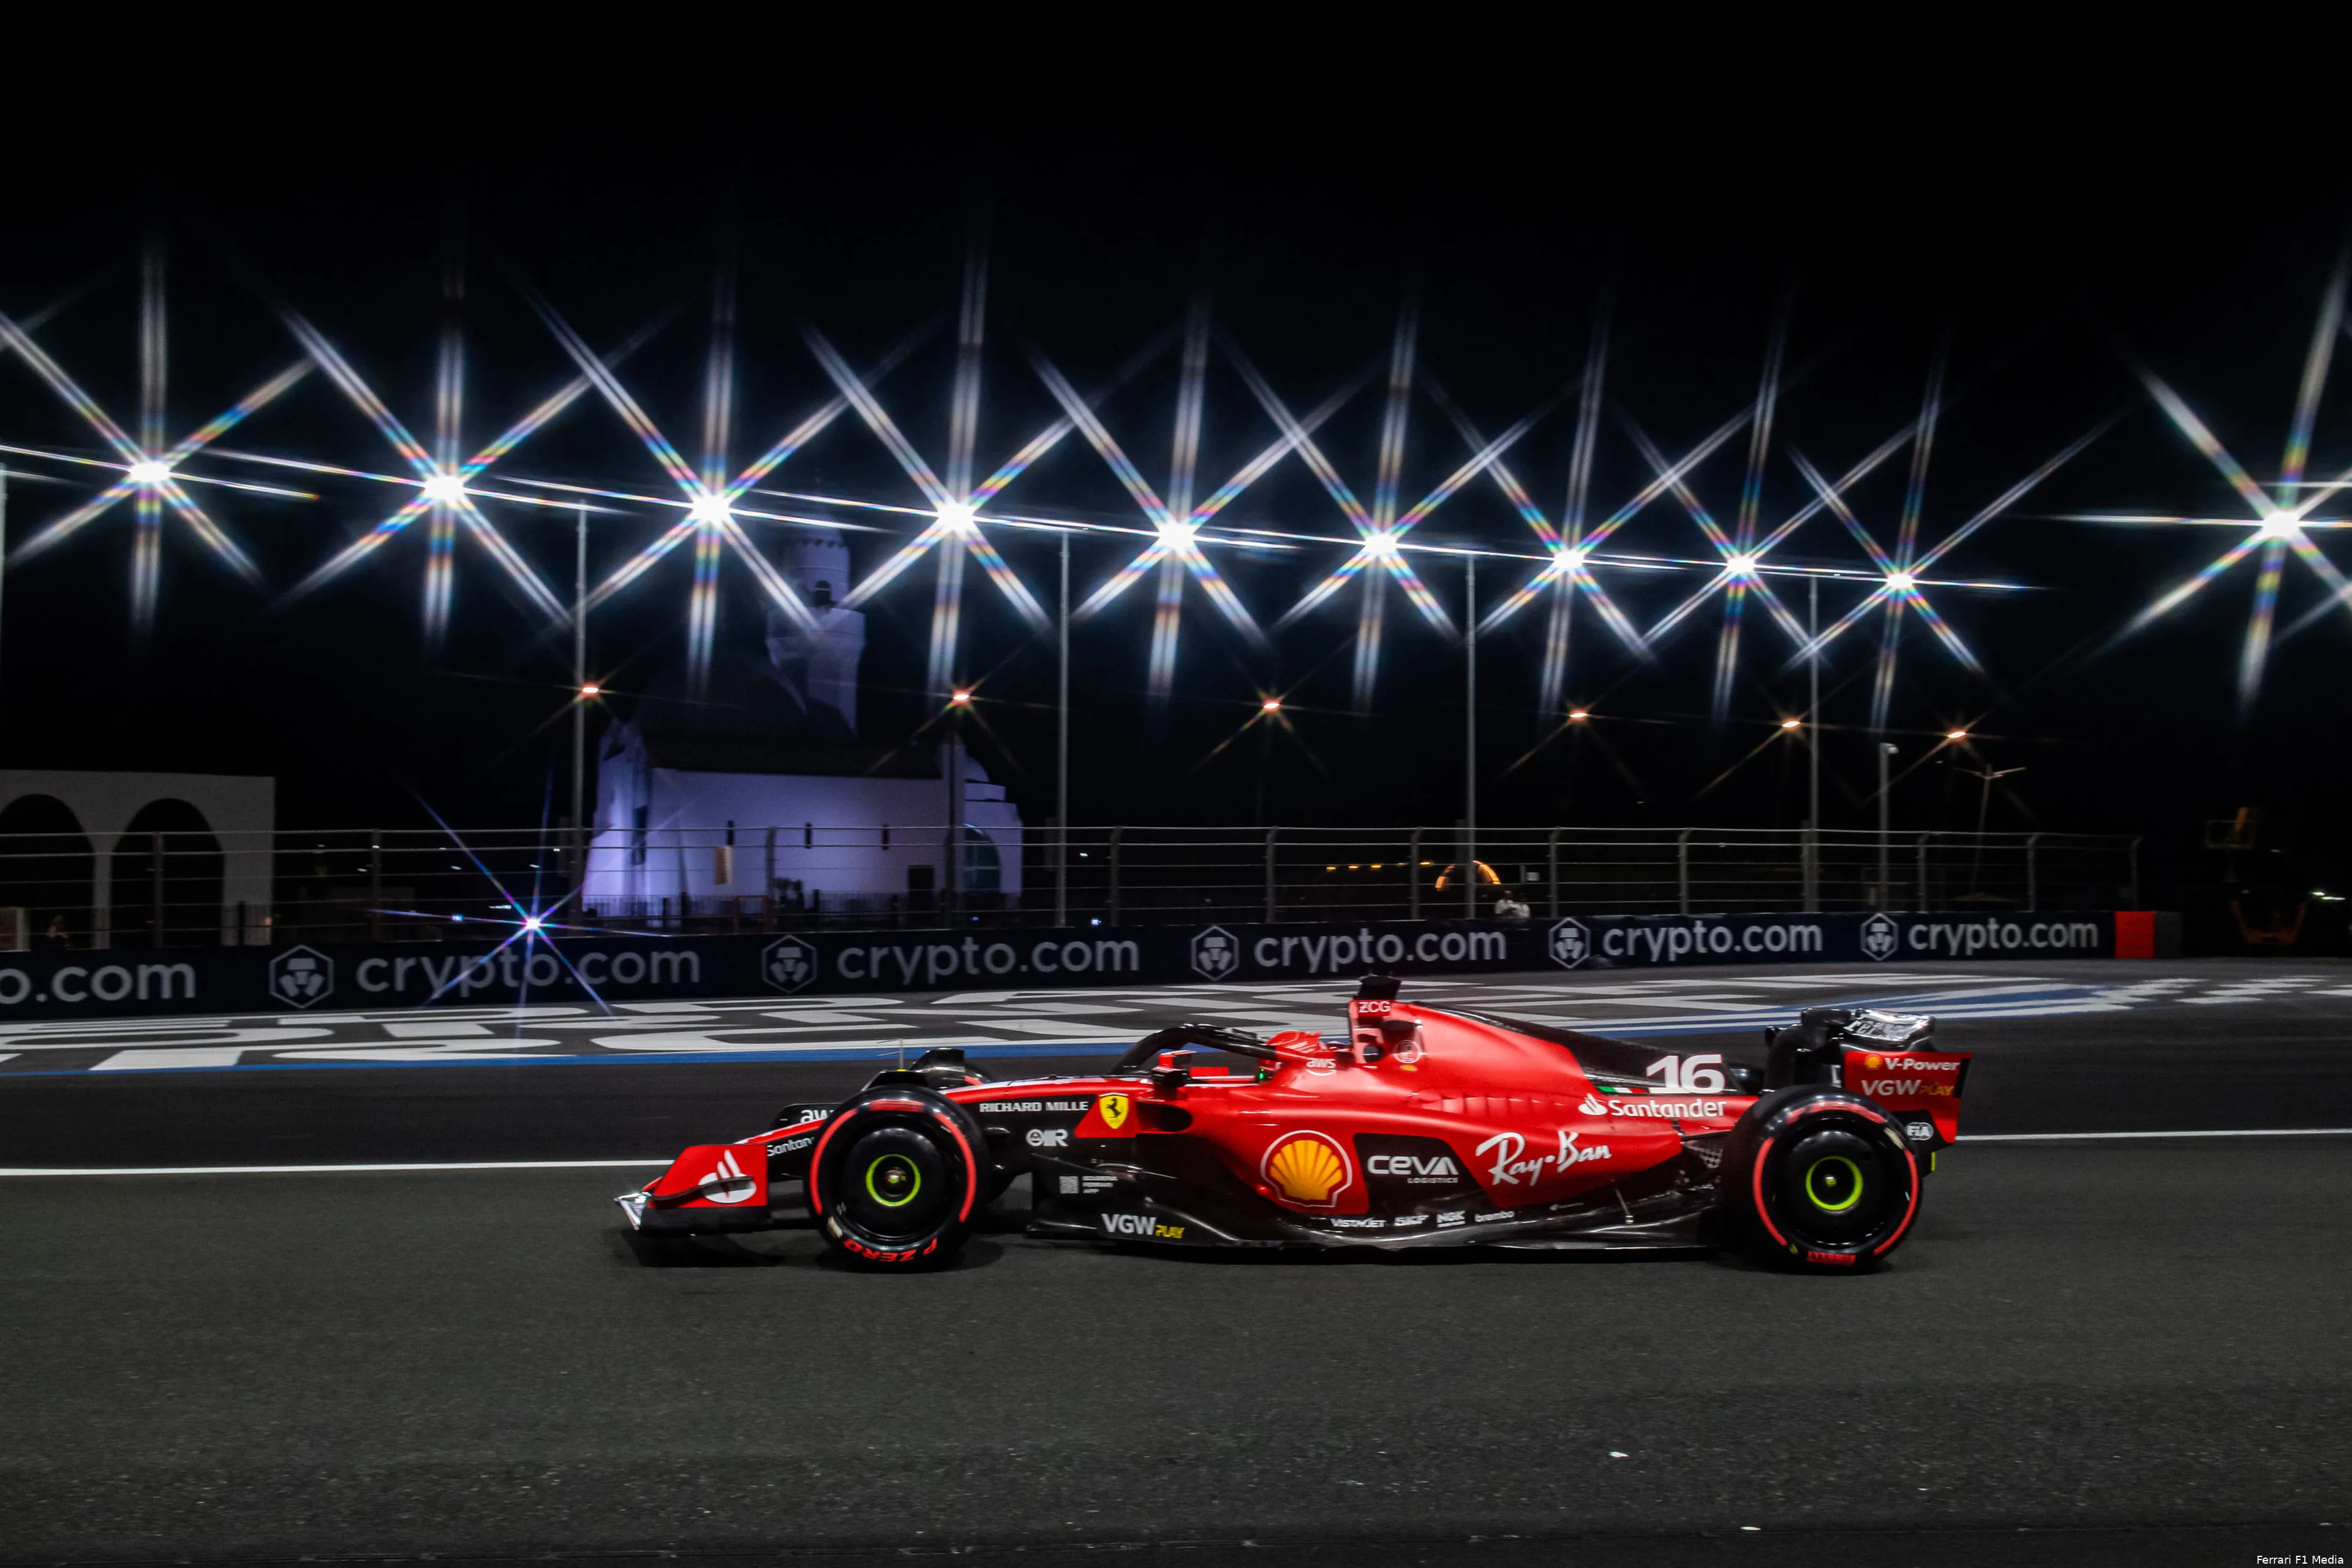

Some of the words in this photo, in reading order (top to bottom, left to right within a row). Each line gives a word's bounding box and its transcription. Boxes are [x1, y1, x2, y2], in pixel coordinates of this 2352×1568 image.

[1602, 920, 1823, 962] crypto.com
[1908, 918, 2098, 956] crypto.com
[837, 937, 1139, 984] crypto.com
[1253, 927, 1507, 973] crypto.com
[355, 947, 700, 998] crypto.com
[1306, 1058, 1336, 1068] aws
[1646, 1054, 1725, 1094] 16
[1885, 1058, 1960, 1071] V-Power
[1861, 1080, 1921, 1095] VGW
[979, 1102, 1041, 1112] RICHARD
[1046, 1101, 1088, 1110] MILLE
[1608, 1099, 1727, 1118] Santander
[1476, 1131, 1612, 1186] Ray-Ban
[1101, 1213, 1156, 1235] VGW
[1155, 1225, 1185, 1238] PLAY
[1437, 1210, 1465, 1223] NGK
[1474, 1210, 1515, 1222] brembo
[843, 1238, 917, 1262] ZERO
